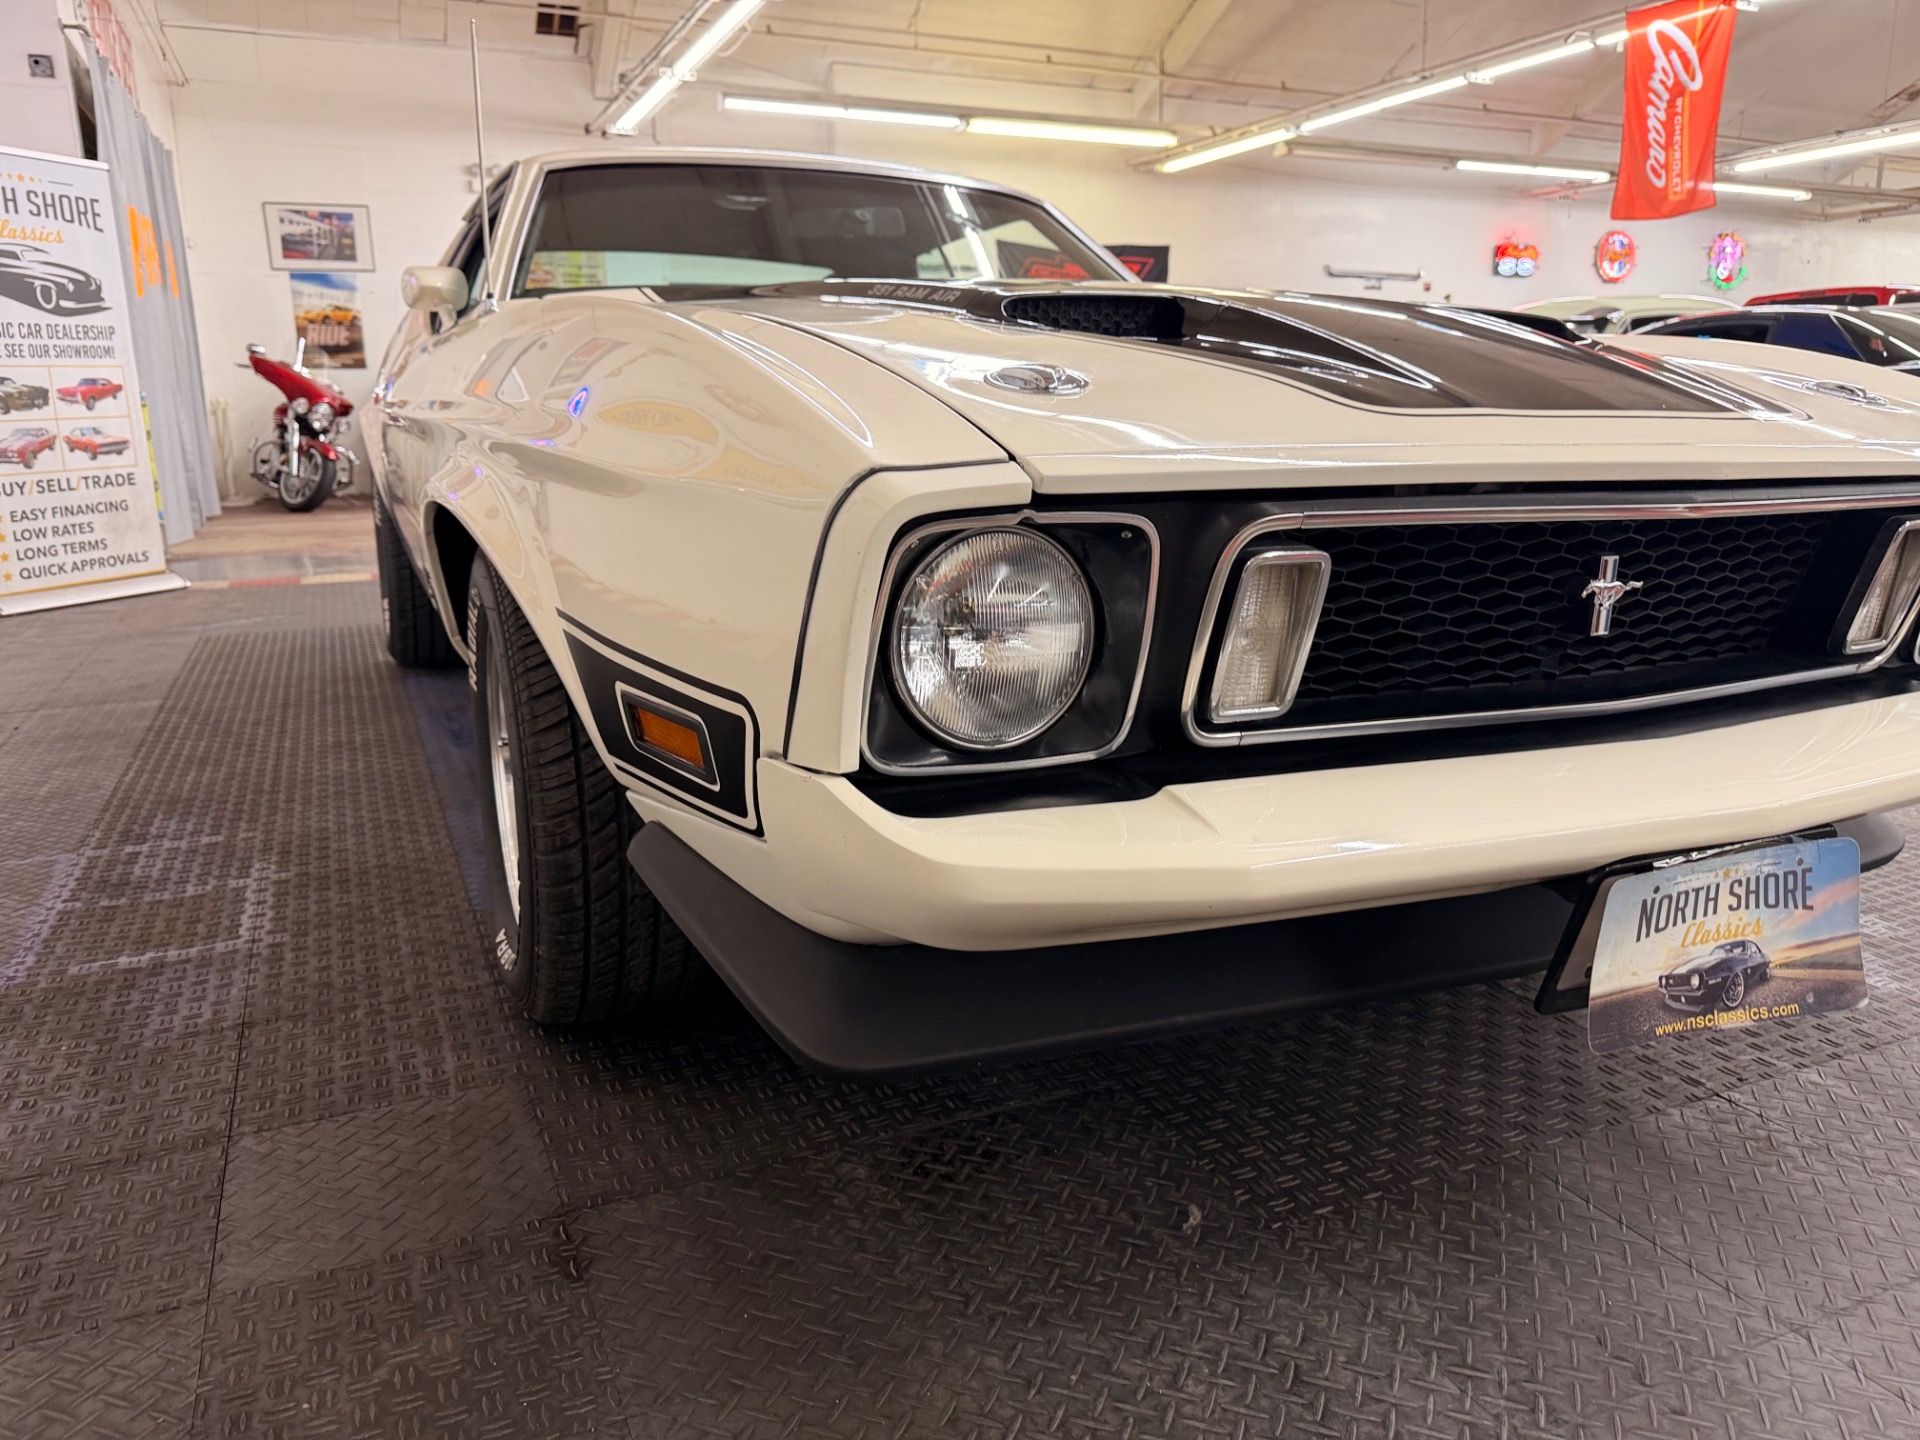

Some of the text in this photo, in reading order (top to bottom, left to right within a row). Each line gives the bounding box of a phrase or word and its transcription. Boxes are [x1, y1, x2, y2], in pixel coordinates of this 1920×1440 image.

[1646, 19, 1703, 189] Camaro
[1672, 115, 1684, 194] CHEVROLET
[26, 190, 104, 233] SHORE
[0, 219, 65, 244] lassics
[893, 285, 931, 299] RAM
[928, 289, 961, 302] AIR
[18, 323, 43, 339] CAR
[46, 324, 116, 341] DEALERSHIP
[4, 343, 26, 358] SEE
[28, 344, 51, 359] OUR
[53, 344, 117, 359] SHOWROOM!
[10, 499, 130, 523] EASY FINANCING
[13, 521, 95, 542] LOW RATES
[16, 538, 108, 561] LONG TERMS
[19, 550, 150, 580] QUICK APPROVALS
[1636, 867, 1814, 943] NORTH SHORE
[1681, 917, 1764, 949] Classics
[1655, 1001, 1800, 1037] www.nsclassics.com
